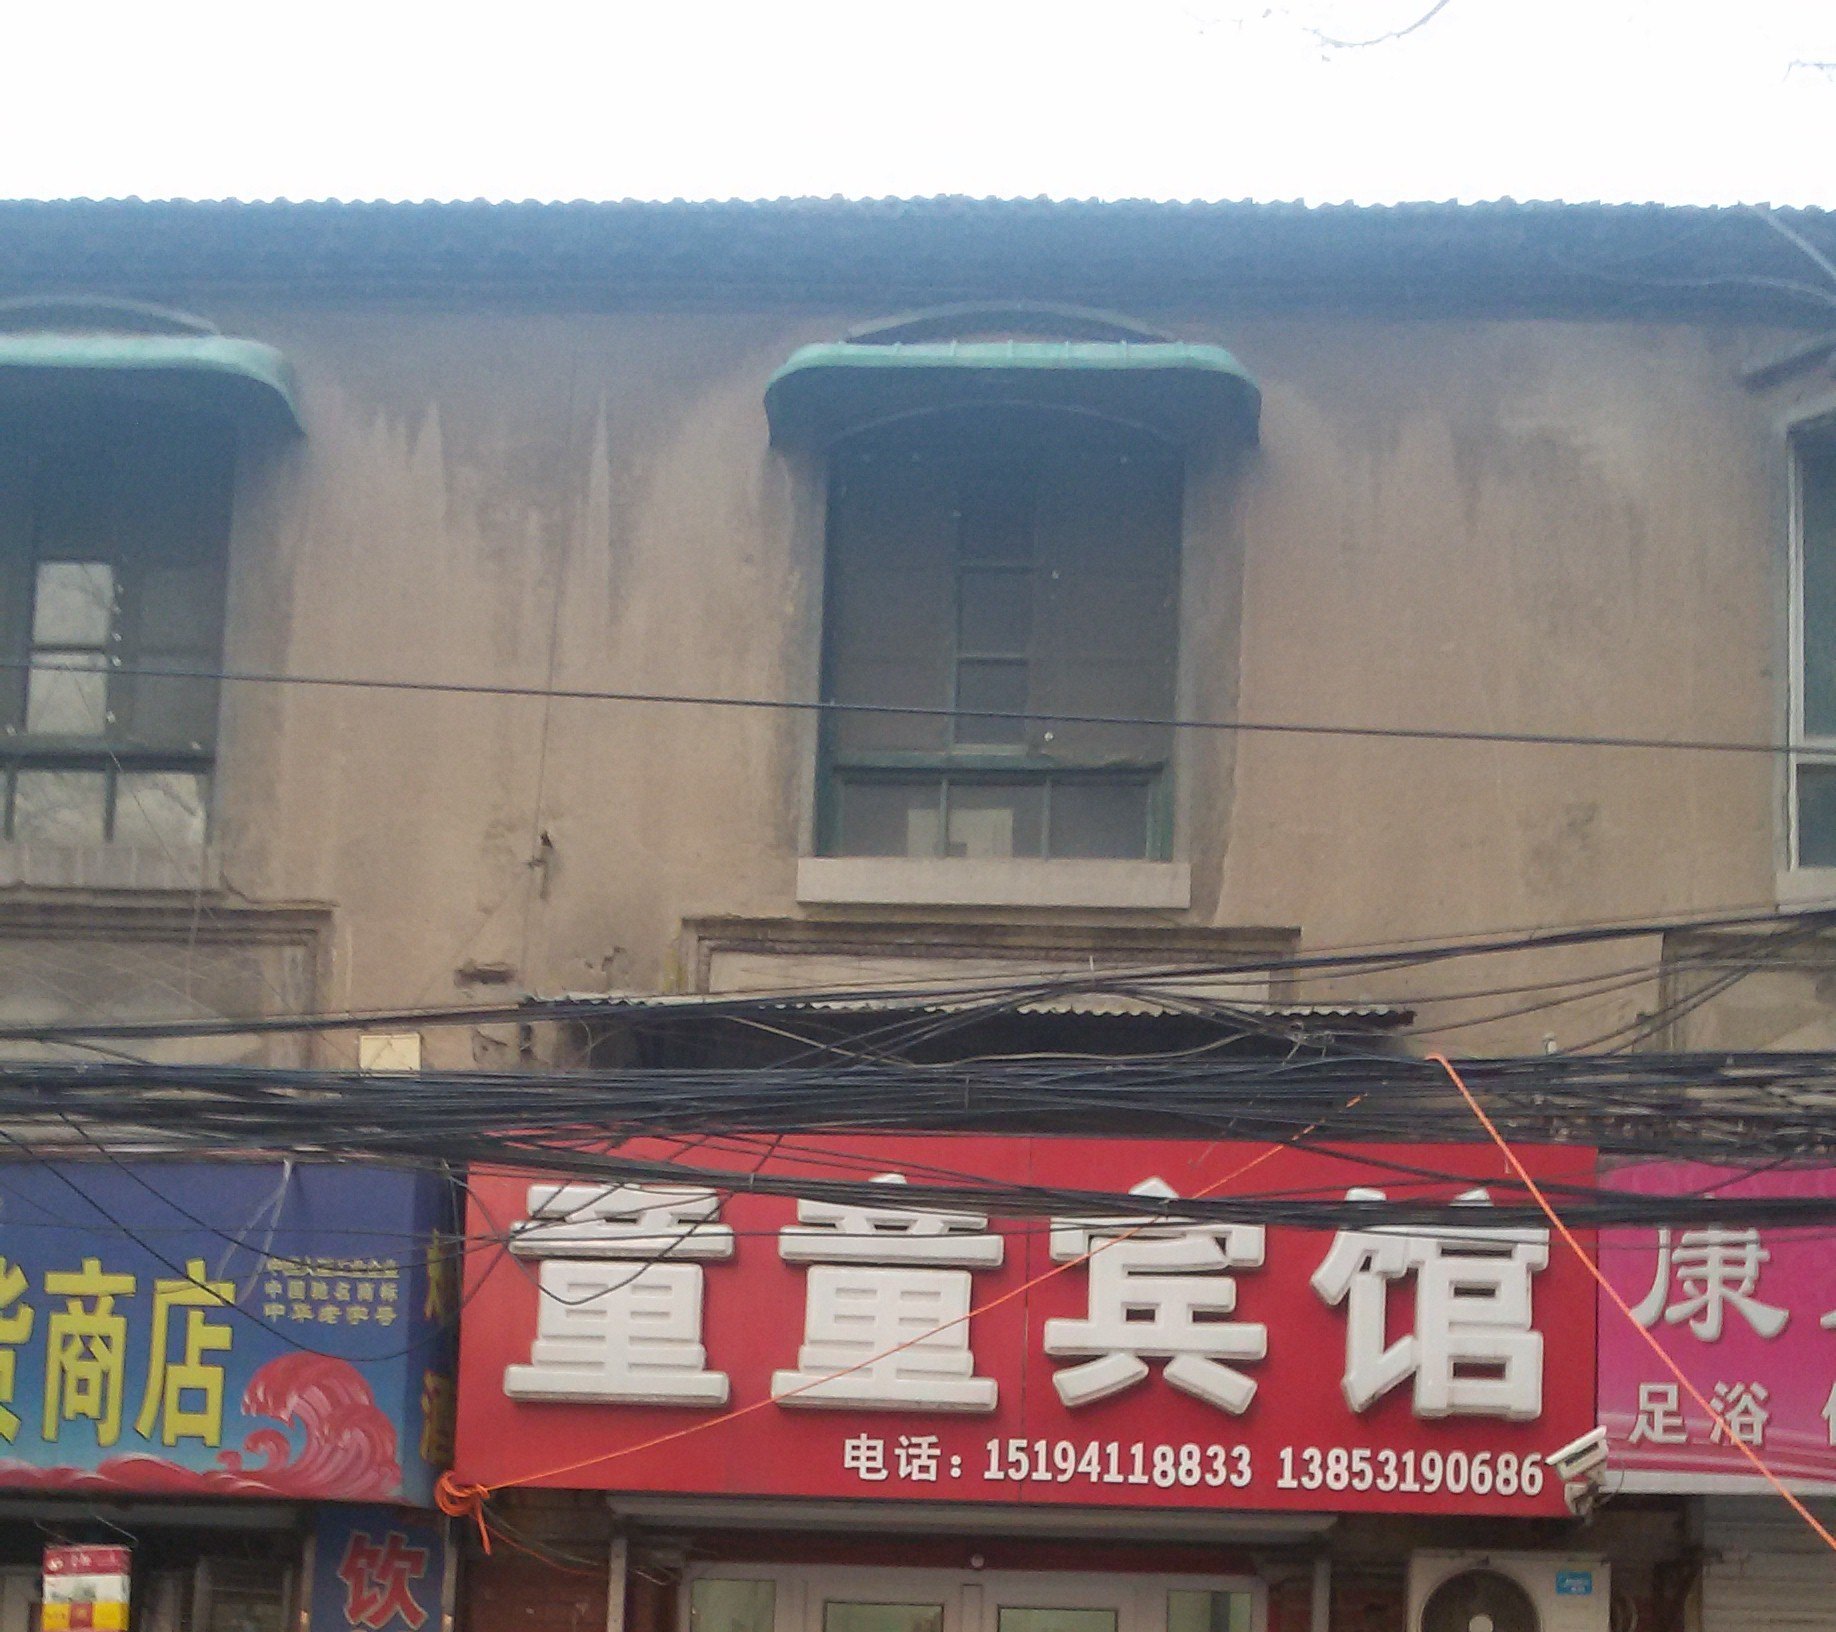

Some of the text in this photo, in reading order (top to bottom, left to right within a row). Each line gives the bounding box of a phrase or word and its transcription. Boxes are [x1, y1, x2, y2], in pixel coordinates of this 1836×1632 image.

[502, 1172, 1552, 1424] 童童宾馆
[1630, 1195, 1836, 1342] 康
[1277, 1445, 1544, 1498] 13853190686
